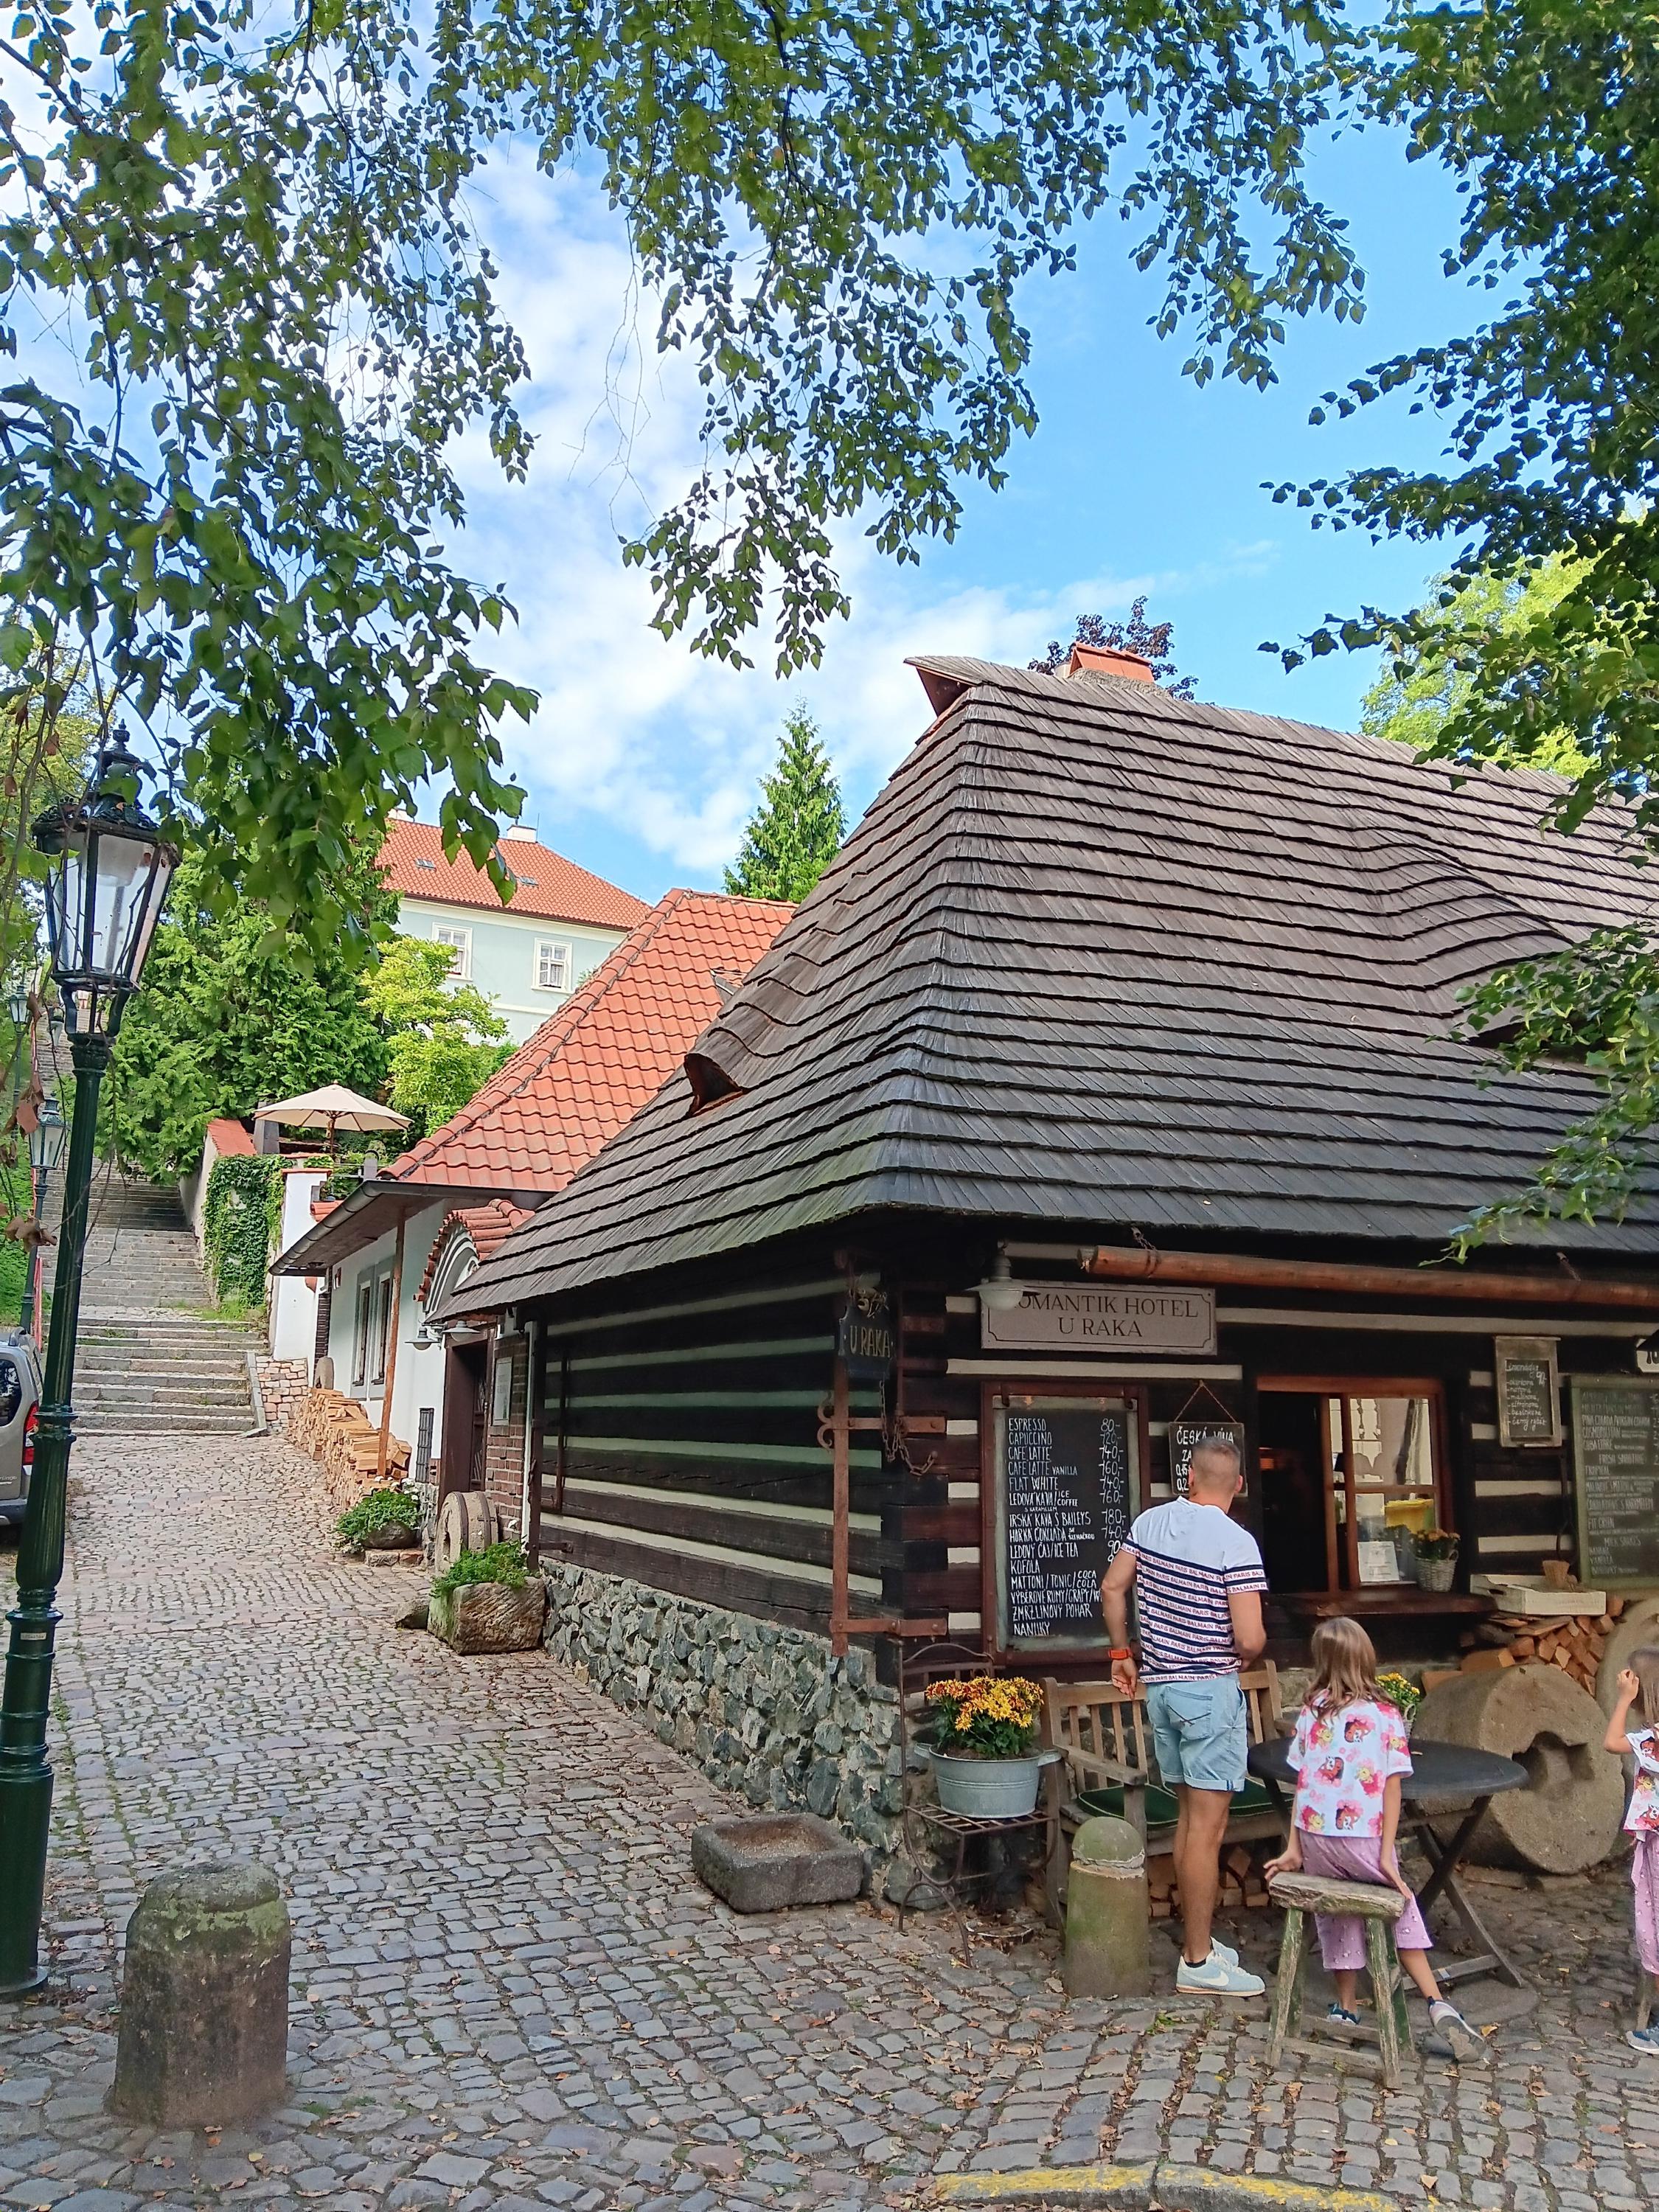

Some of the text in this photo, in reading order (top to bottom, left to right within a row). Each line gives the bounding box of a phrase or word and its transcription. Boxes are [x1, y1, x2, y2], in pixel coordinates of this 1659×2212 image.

[1015, 1293, 1197, 1318] OMANTIK HOTEL
[1059, 1318, 1143, 1338] U RAKA
[850, 1326, 891, 1357] U RAKA
[1009, 1418, 1046, 1431] ESPRESSO
[1009, 1432, 1052, 1445] CAPUCCINO
[1052, 1466, 1077, 1475] VANILLA
[1009, 1476, 1029, 1491] FLAT
[1031, 1476, 1058, 1490] WHITE
[1062, 1512, 1091, 1526] BAILEYS
[1065, 1542, 1079, 1558] TEA
[1010, 1559, 1040, 1574] KOFOLA
[1077, 1579, 1097, 1589] COLA
